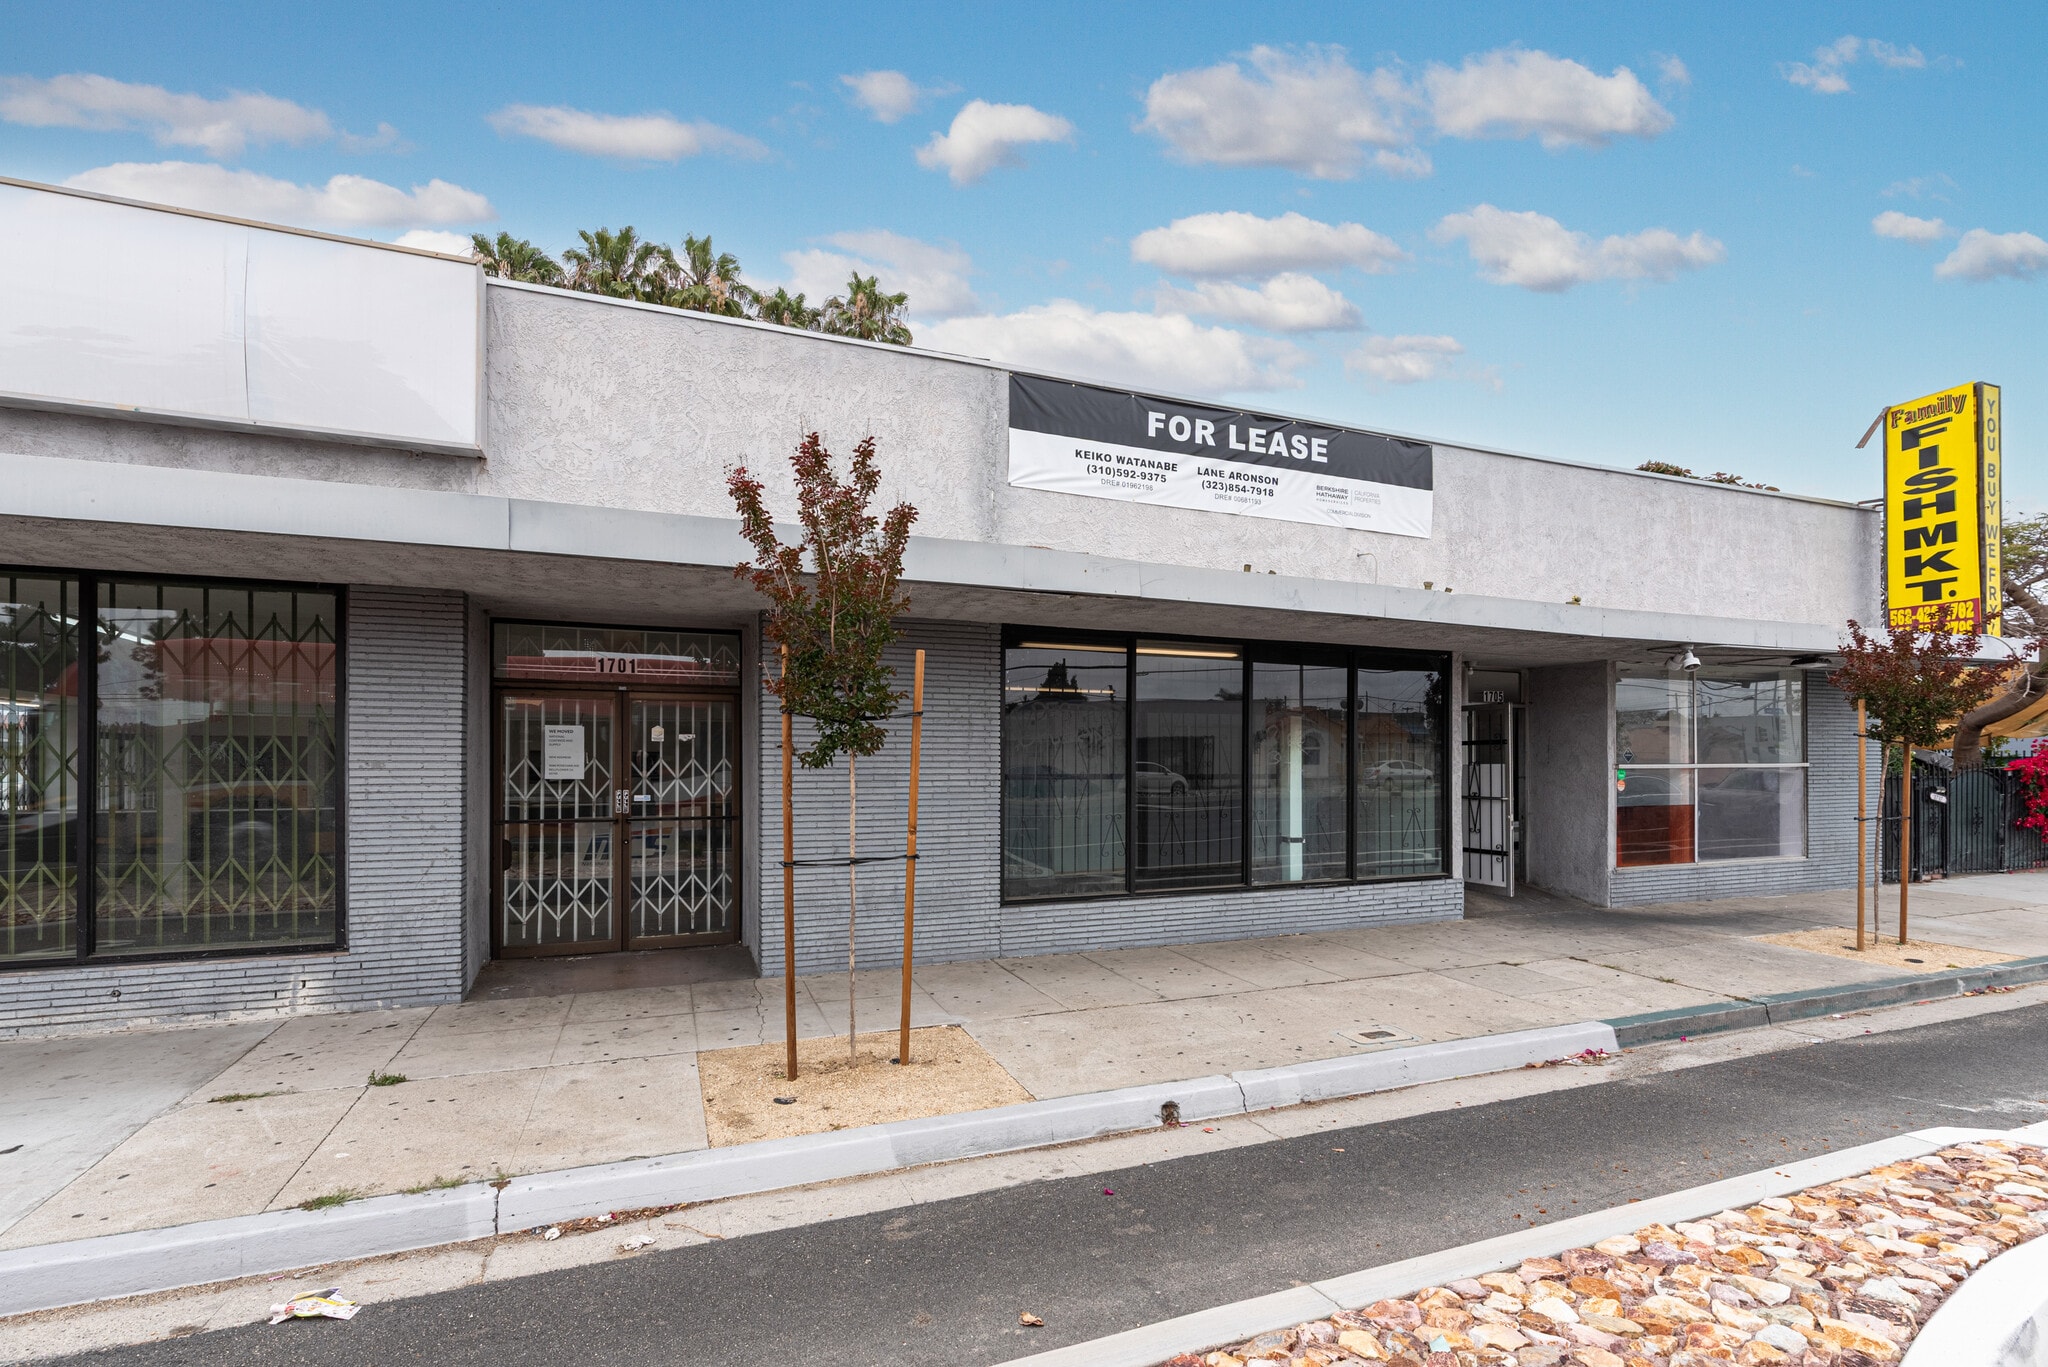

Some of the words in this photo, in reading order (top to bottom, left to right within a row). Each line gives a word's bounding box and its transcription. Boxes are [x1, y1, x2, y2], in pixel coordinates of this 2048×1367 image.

[1890, 394, 1967, 429] Family
[1987, 398, 1996, 452] YOU
[1147, 410, 1217, 447] FOR
[1228, 423, 1329, 465] LEASE
[1074, 449, 1112, 463] KEIKO
[1116, 455, 1178, 472] WATANABE
[1086, 463, 1167, 483] (310)592-9375
[1100, 478, 1120, 487] DRE#
[1197, 466, 1225, 478] LANE
[1228, 471, 1279, 486] ARONSON
[1201, 480, 1274, 497] (323)854-7918
[1316, 485, 1349, 494] BERKSHIRE
[1316, 492, 1349, 500] HATHAWAY
[1987, 463, 1996, 515] BUY
[1986, 524, 1998, 559] WE
[598, 657, 636, 673] 1701
[1484, 691, 1504, 702] 1705
